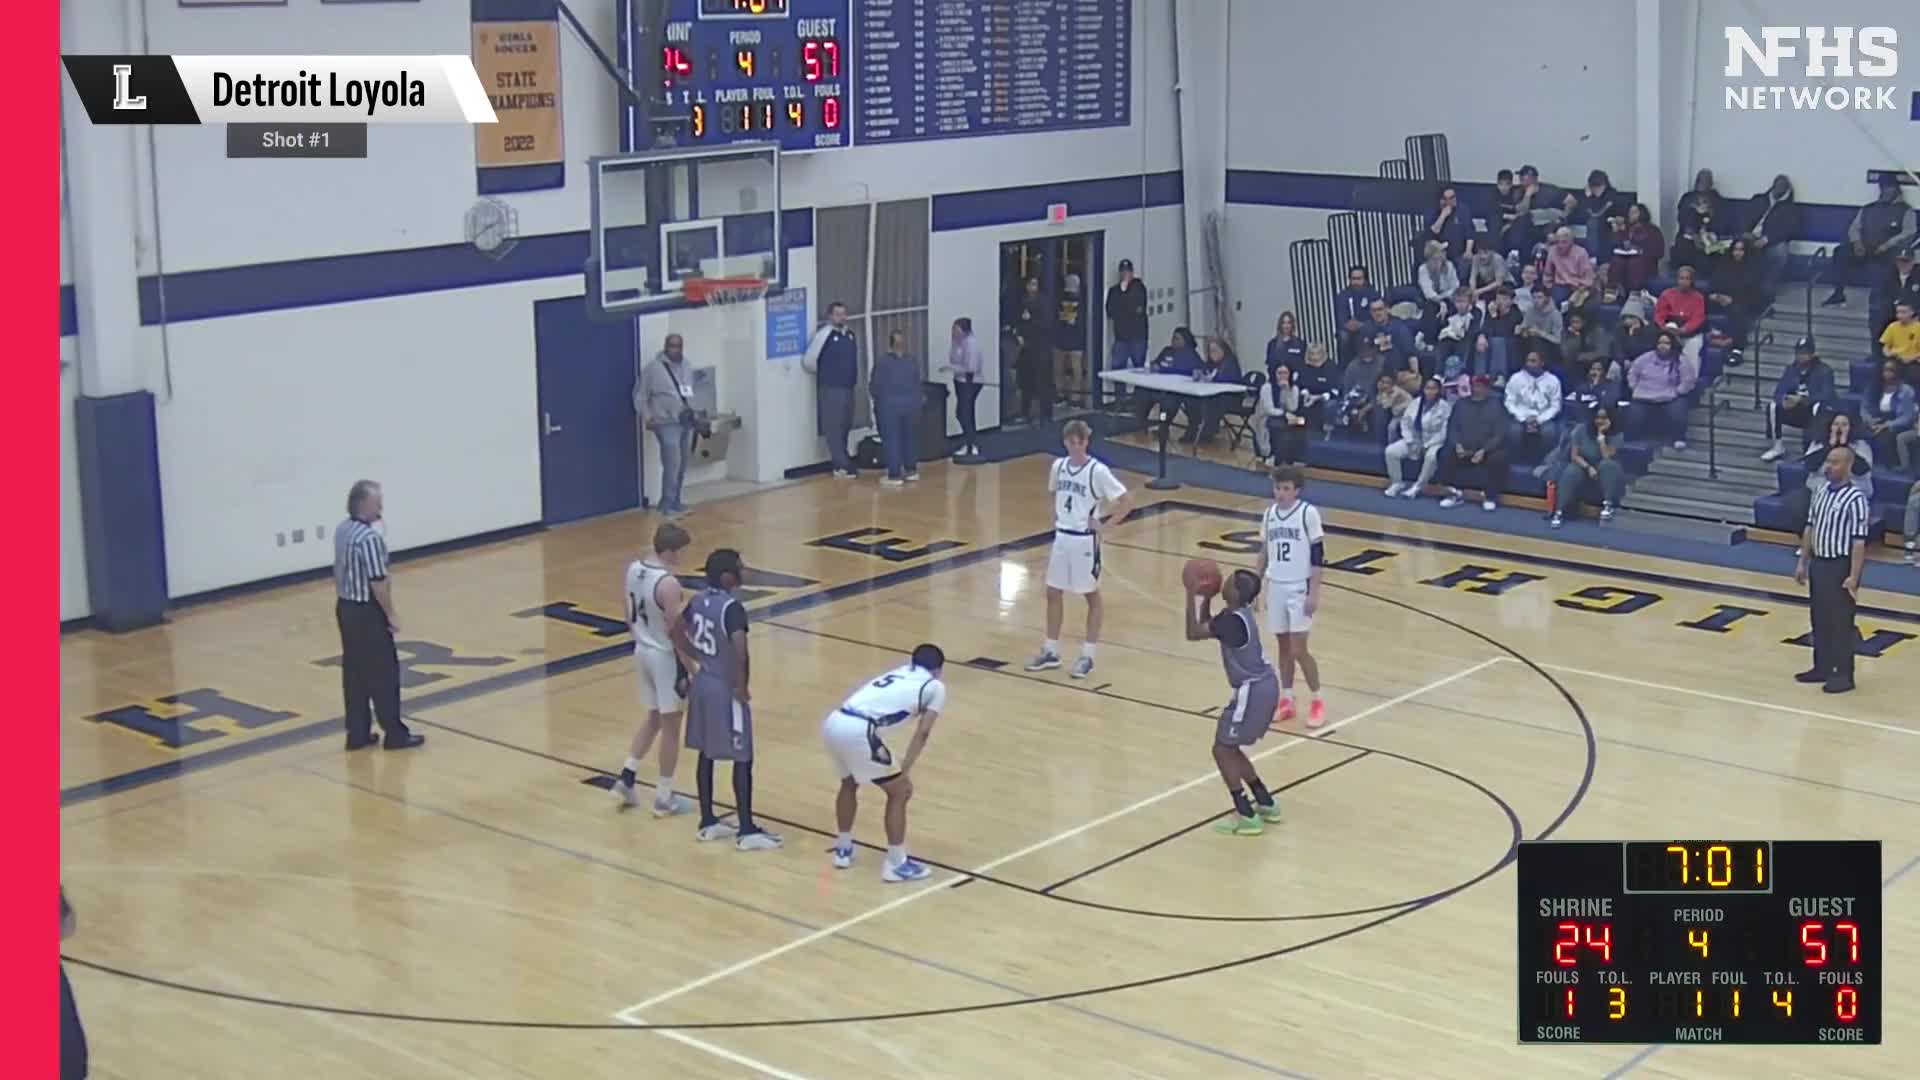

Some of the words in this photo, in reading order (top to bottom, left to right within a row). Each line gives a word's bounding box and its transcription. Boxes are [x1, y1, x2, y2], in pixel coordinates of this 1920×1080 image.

[797, 19, 836, 38] GUEST
[738, 51, 753, 77] 4
[804, 42, 838, 80] 57
[495, 71, 537, 89] STATE
[788, 102, 802, 128] 4
[824, 98, 838, 129] 0
[504, 135, 535, 152] 2022
[1063, 495, 1073, 514] 4
[1276, 541, 1291, 562] 12
[690, 612, 717, 656] 25
[872, 674, 905, 688] 5
